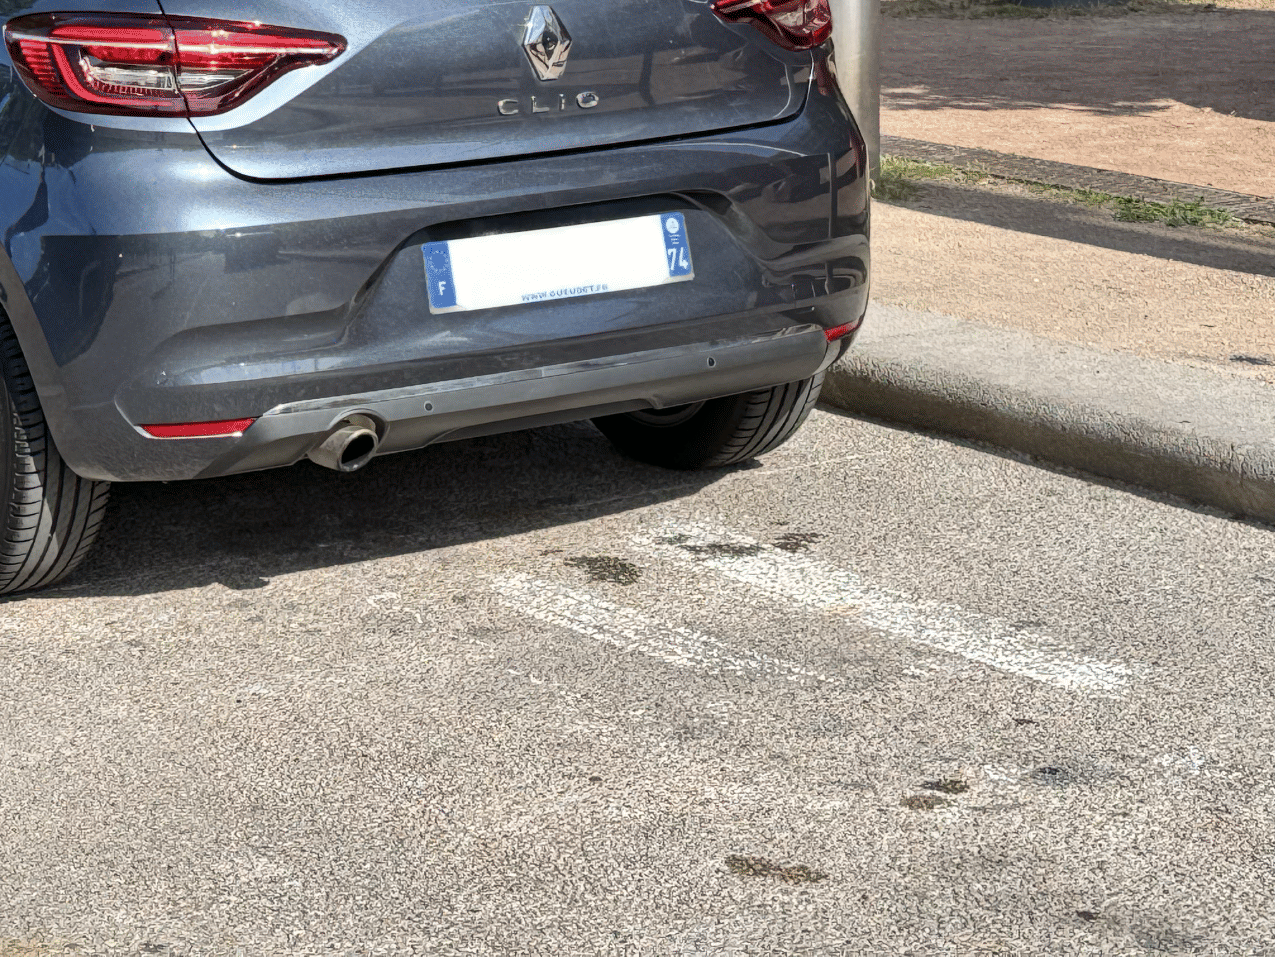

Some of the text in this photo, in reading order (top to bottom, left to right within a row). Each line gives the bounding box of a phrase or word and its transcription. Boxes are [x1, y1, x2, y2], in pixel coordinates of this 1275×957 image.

[498, 91, 599, 115] CLIO
[667, 246, 689, 271] 74
[438, 280, 447, 296] F
